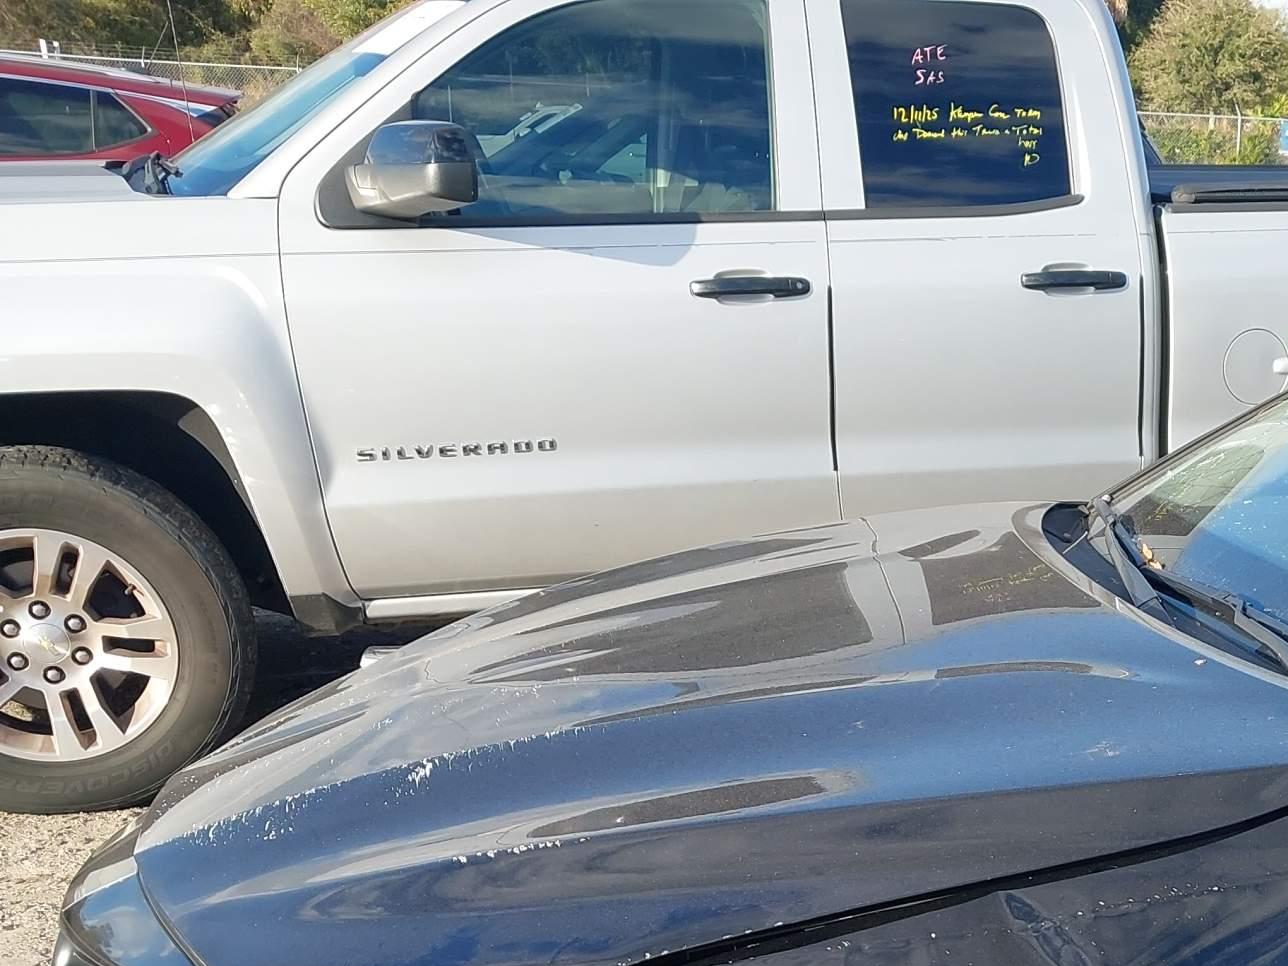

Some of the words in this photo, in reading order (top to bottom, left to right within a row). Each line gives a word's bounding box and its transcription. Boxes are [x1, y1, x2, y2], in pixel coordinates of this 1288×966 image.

[911, 44, 948, 64] ATE
[914, 69, 945, 85] SAS
[893, 104, 938, 123] 12/11/25
[356, 438, 558, 462] SILVERADO
